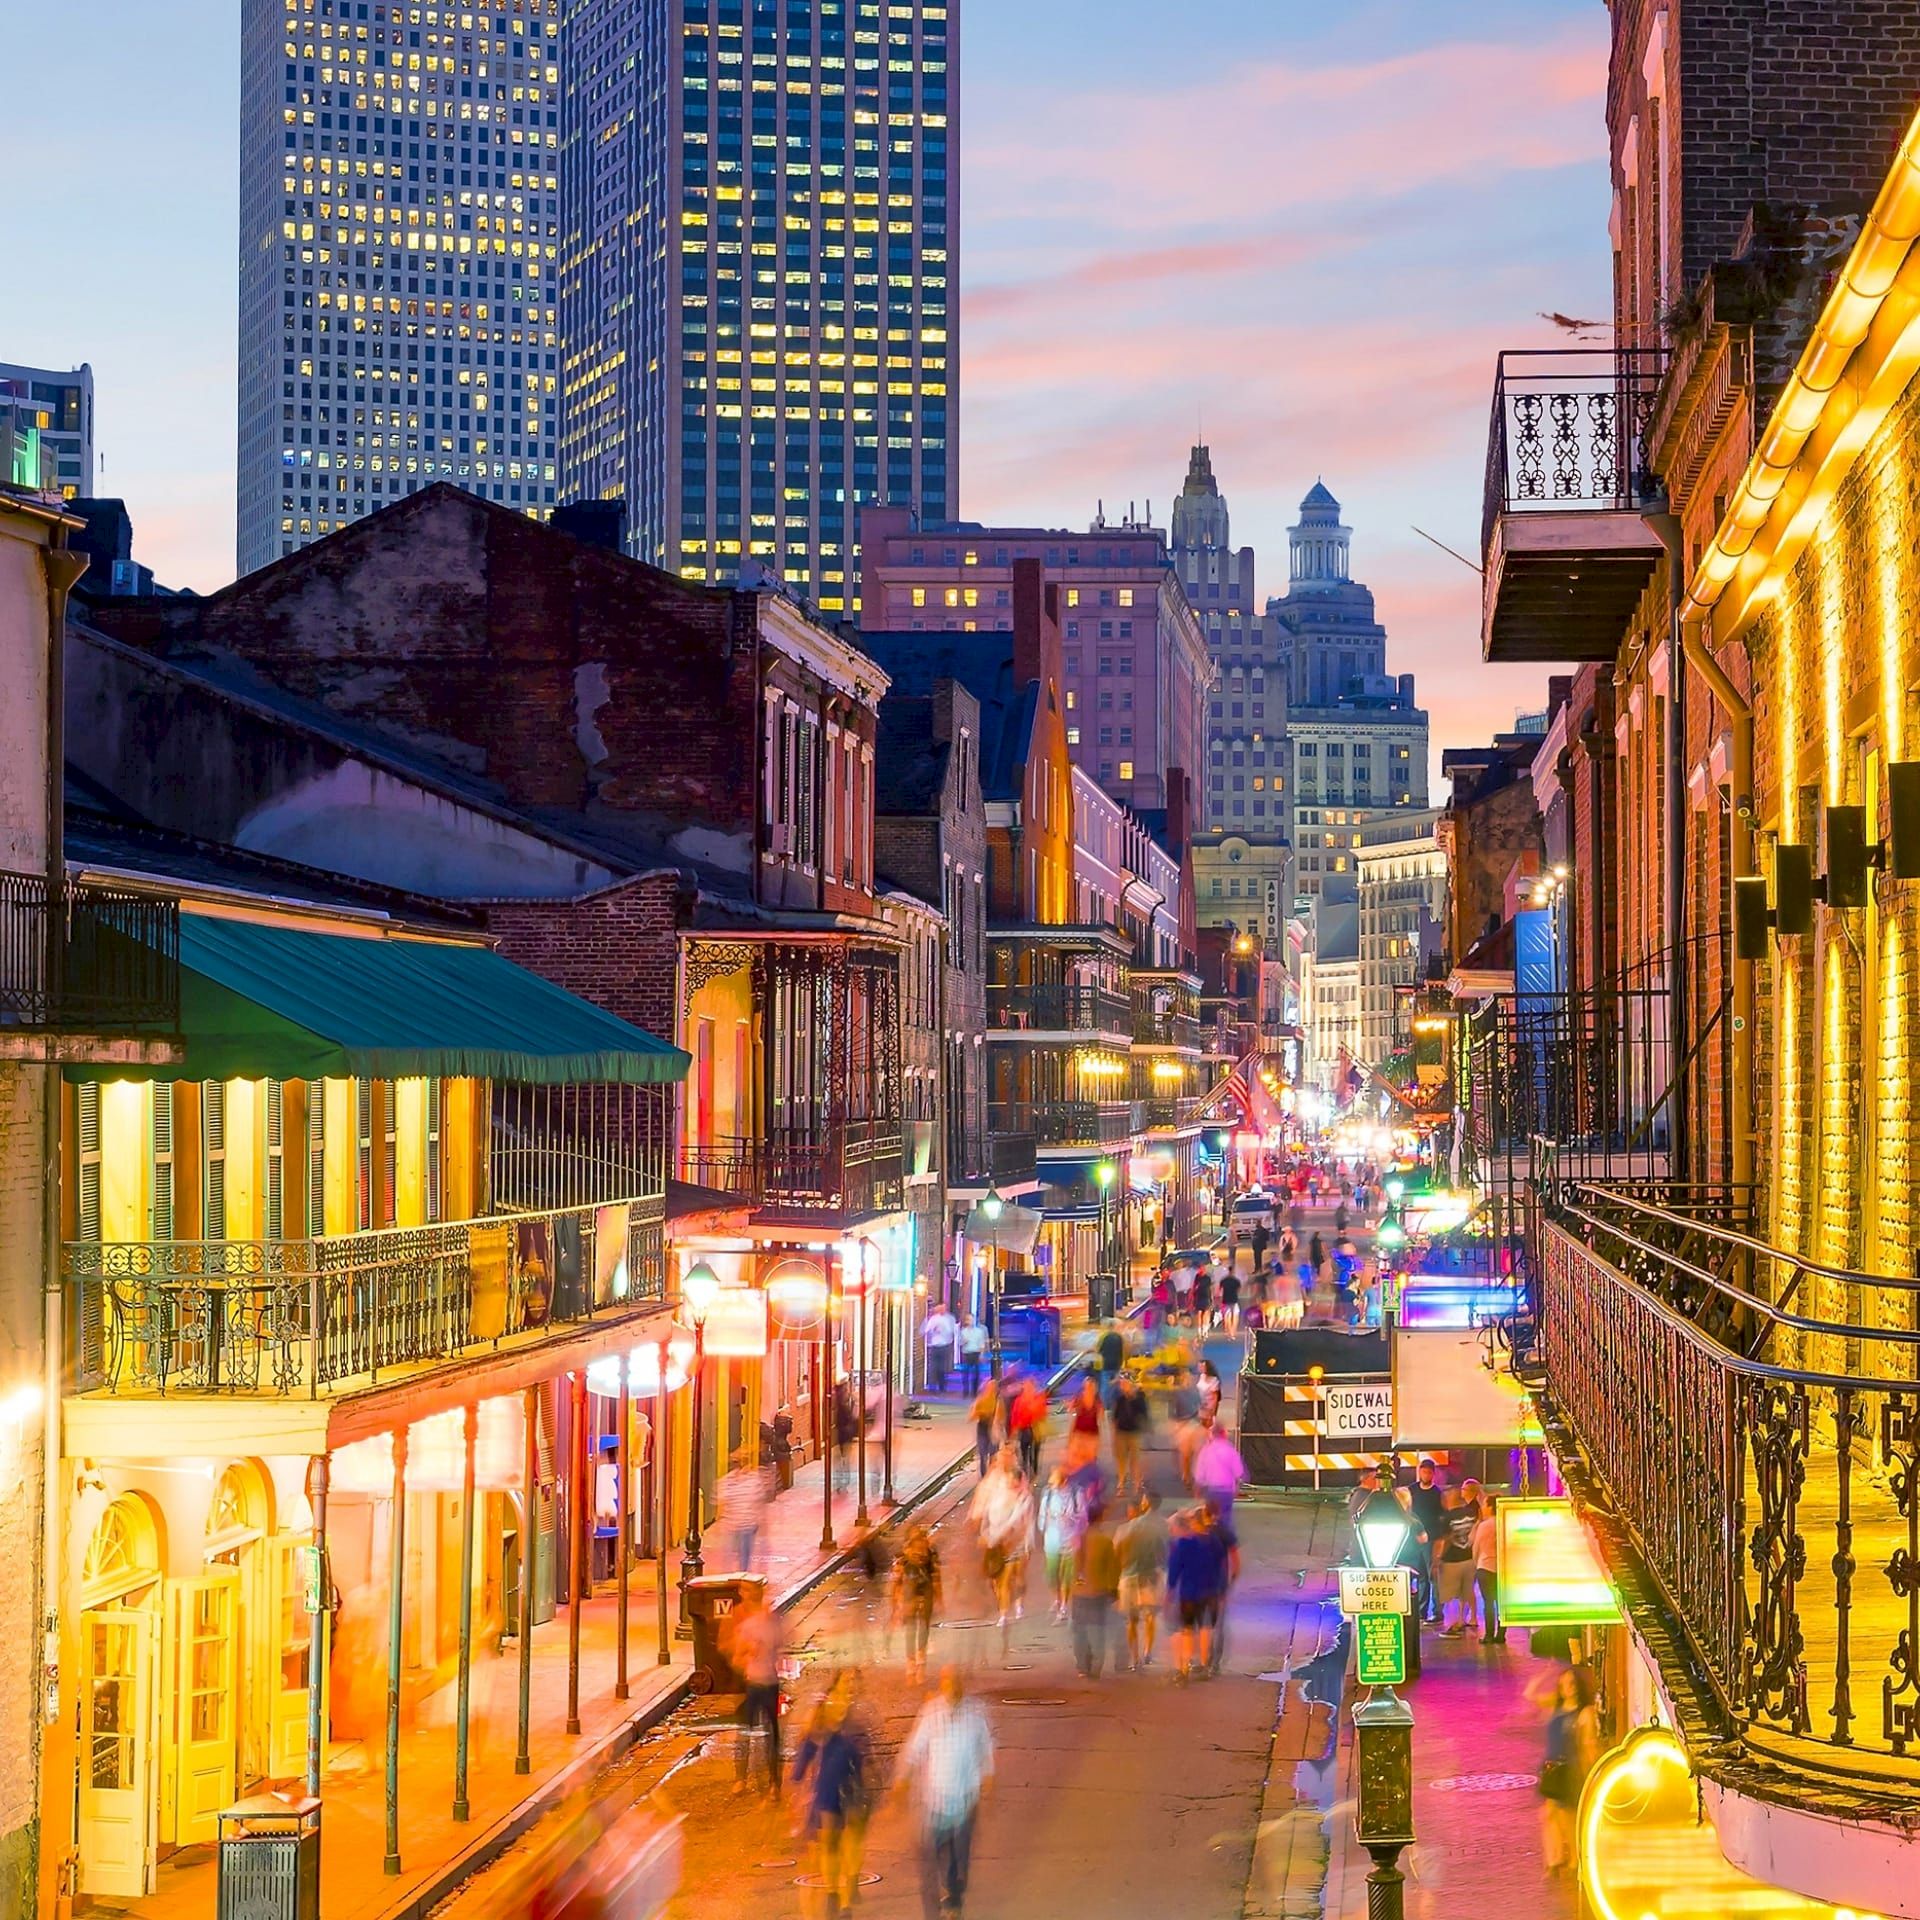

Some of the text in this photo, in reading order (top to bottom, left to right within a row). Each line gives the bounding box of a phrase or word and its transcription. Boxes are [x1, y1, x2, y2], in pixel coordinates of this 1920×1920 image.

[1267, 881, 1275, 936] ASTOR
[1330, 1392, 1392, 1408] SIDEWAL
[1339, 1413, 1392, 1429] CLOSED
[1349, 1573, 1399, 1583] SIDEWALK
[1355, 1587, 1394, 1597] CLOSED
[1362, 1601, 1388, 1610] HERE
